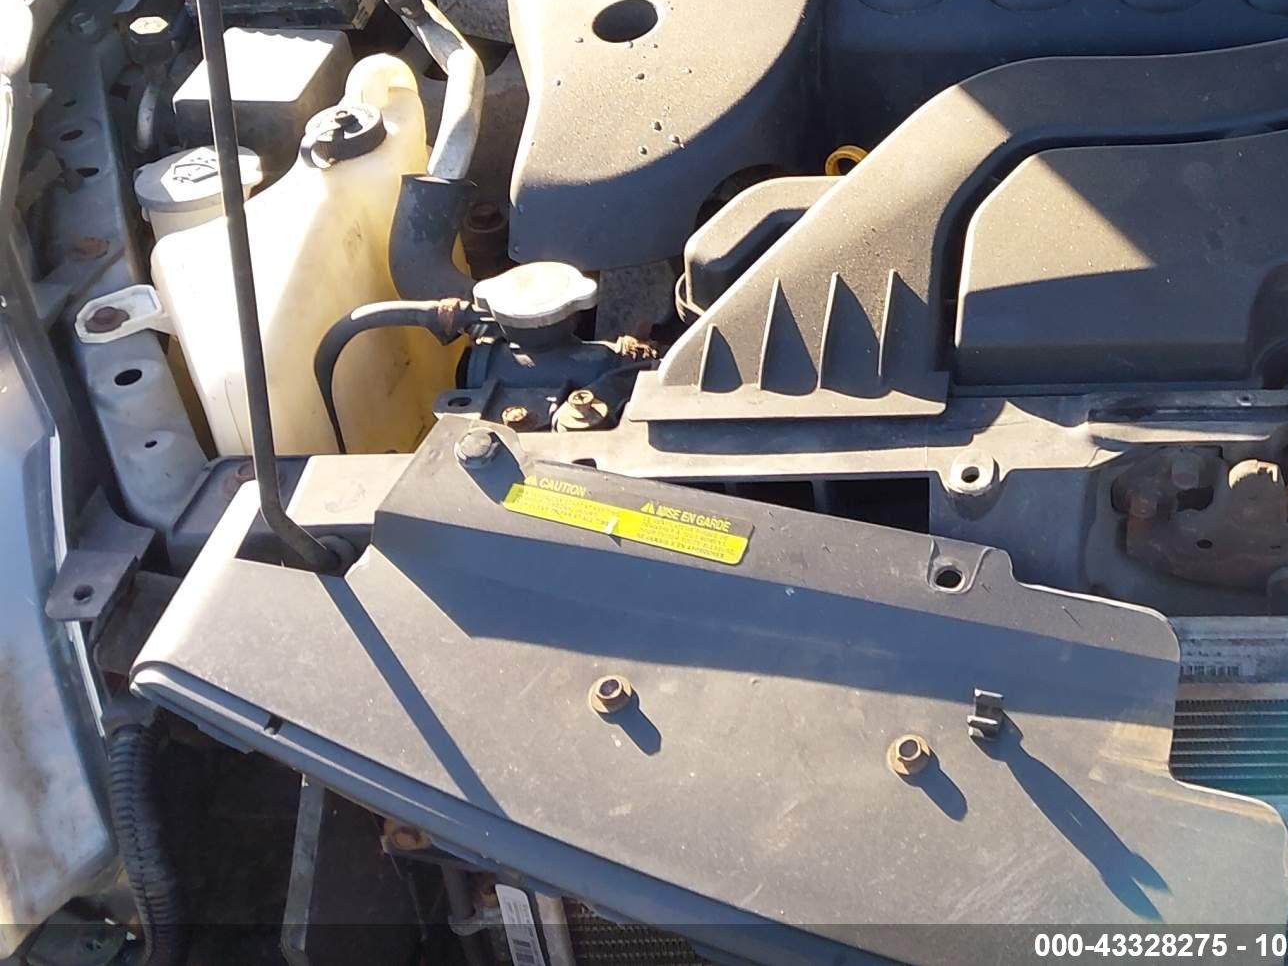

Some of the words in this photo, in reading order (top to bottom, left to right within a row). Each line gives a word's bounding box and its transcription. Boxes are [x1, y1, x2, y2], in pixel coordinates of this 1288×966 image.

[539, 477, 587, 496] CAUTION
[680, 512, 697, 525] EN
[696, 515, 732, 533] GARDE
